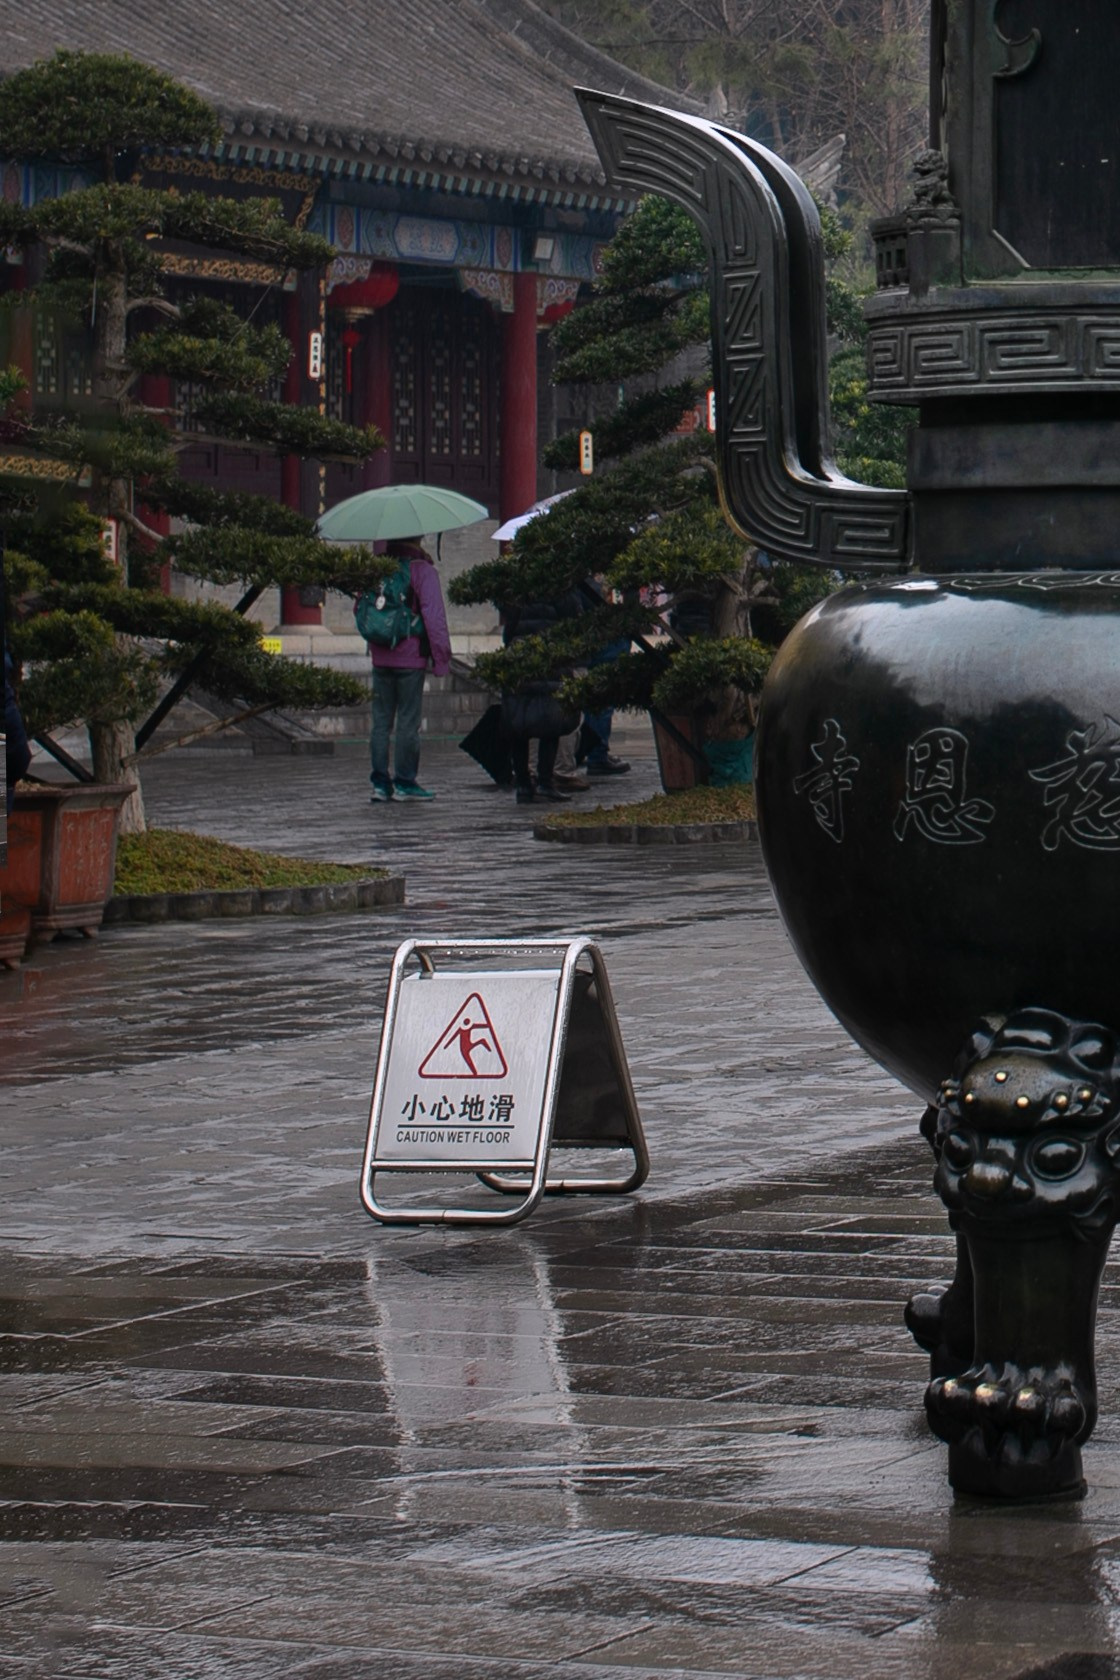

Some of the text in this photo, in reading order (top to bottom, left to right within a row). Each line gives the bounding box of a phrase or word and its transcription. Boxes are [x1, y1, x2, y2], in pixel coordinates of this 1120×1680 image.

[401, 1094, 515, 1122] 小心地滑
[396, 1130, 510, 1144] CAUTION WET FLOOR
